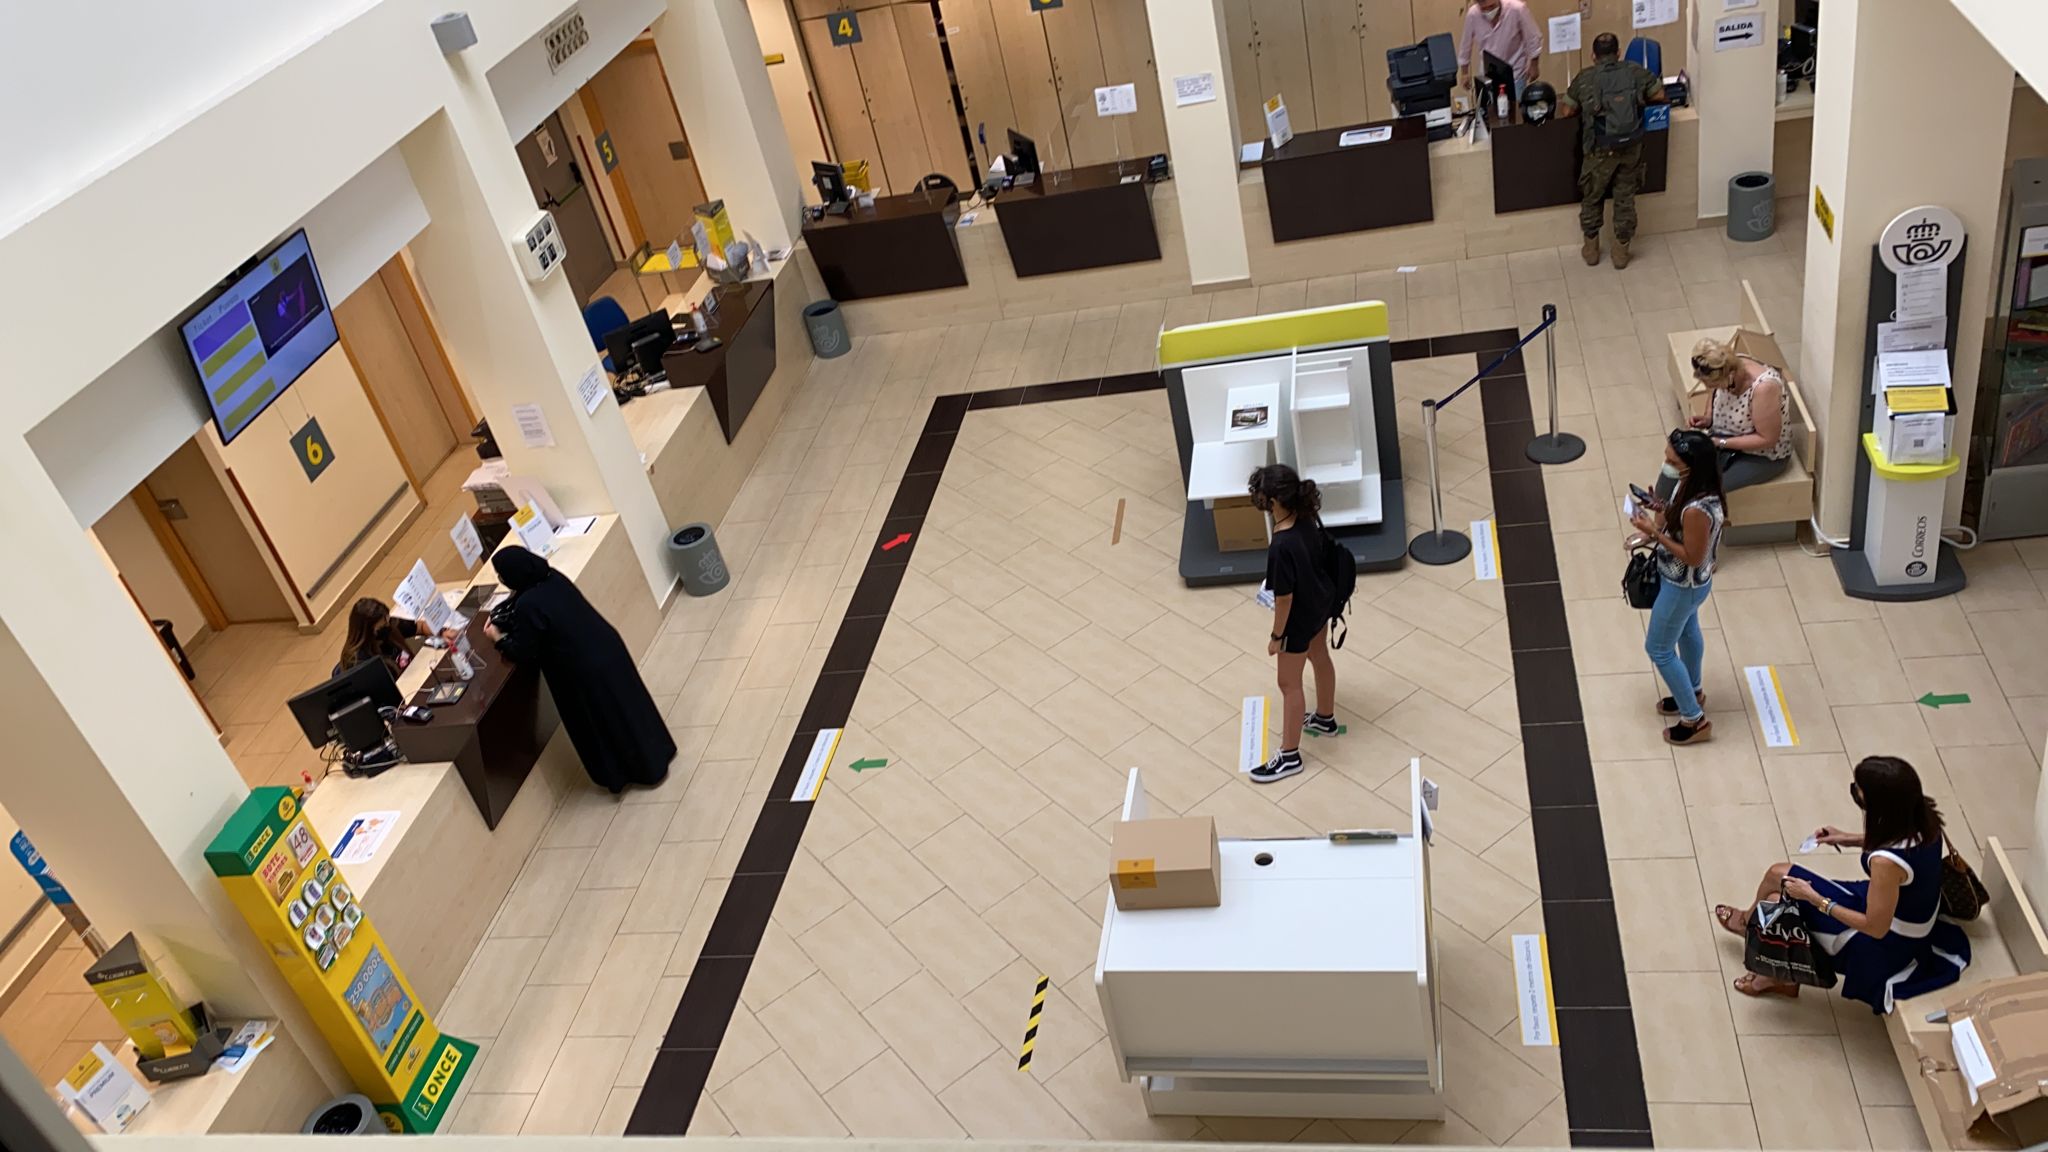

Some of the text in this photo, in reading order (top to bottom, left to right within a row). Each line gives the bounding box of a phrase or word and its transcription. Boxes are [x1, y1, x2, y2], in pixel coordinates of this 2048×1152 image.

[838, 17, 854, 37] 4
[1719, 21, 1753, 33] SALIDA
[602, 138, 613, 164] 5
[306, 434, 324, 466] 6
[253, 829, 271, 854] ONCE
[293, 826, 309, 849] 48
[427, 1049, 457, 1097] ONCE
